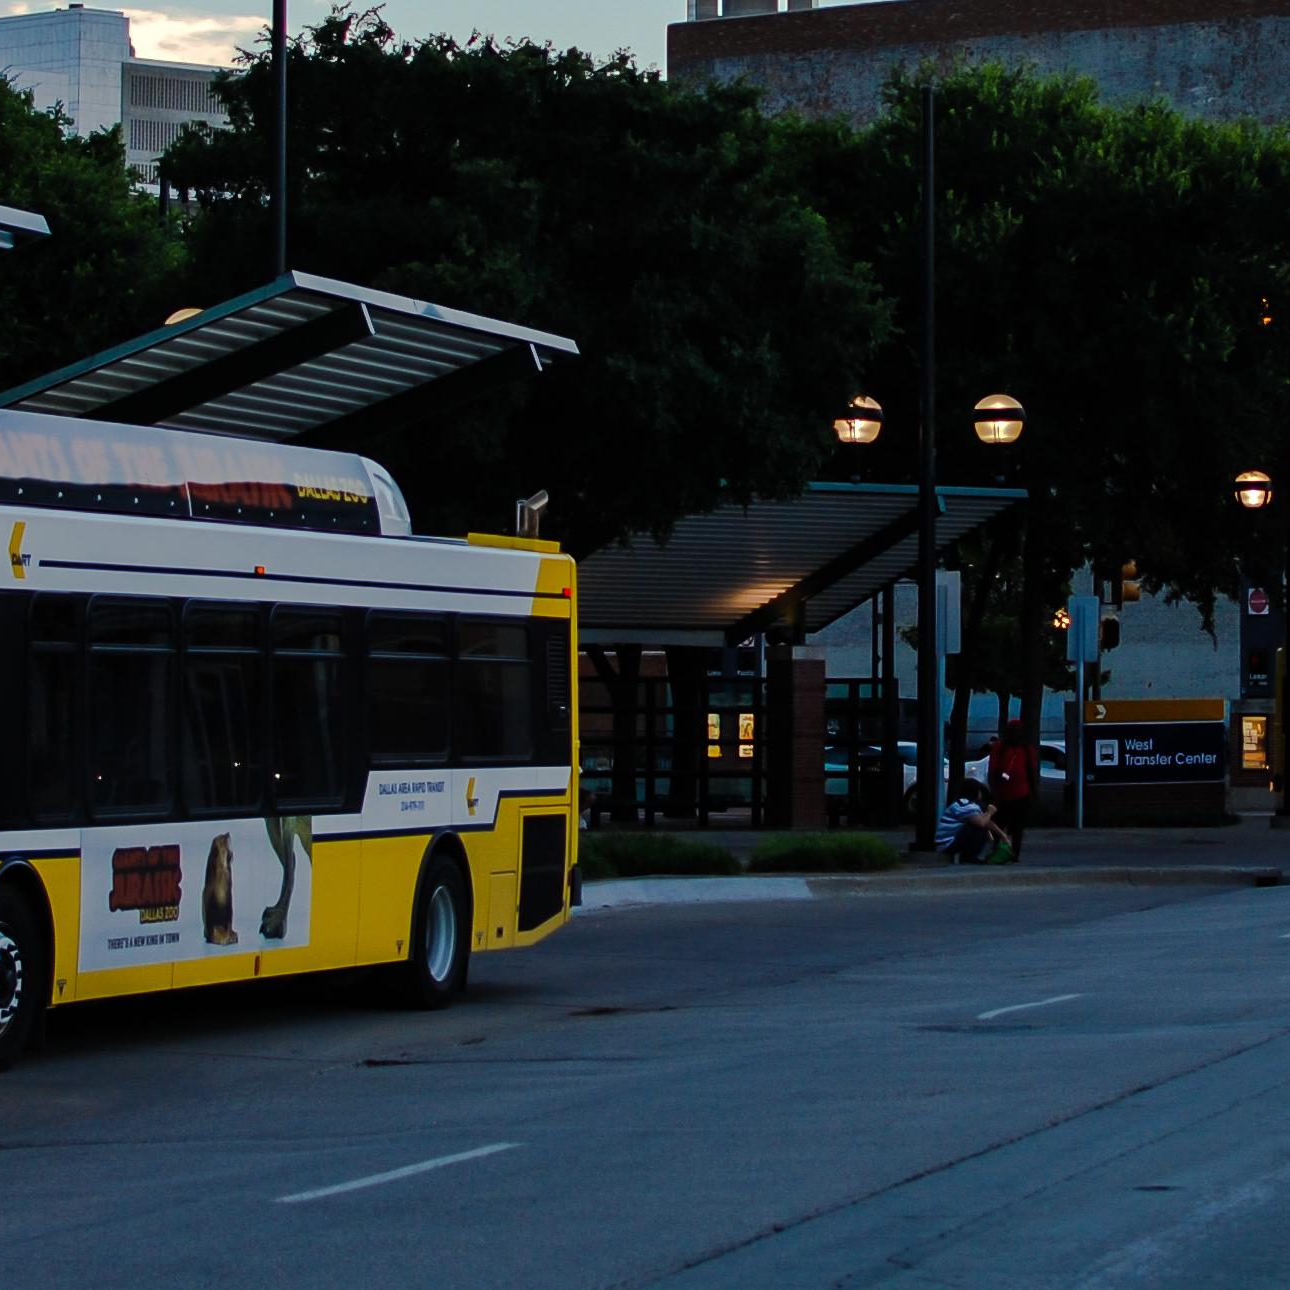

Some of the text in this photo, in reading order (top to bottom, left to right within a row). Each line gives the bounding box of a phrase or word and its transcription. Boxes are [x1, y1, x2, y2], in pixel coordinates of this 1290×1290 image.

[1124, 738, 1153, 751] West
[1125, 752, 1217, 767] Transfer Center
[379, 783, 398, 796] DALLAS
[399, 782, 411, 794] AREA
[141, 905, 178, 922] DALLAS ZOO
[134, 936, 145, 947] NEW
[165, 932, 180, 944] TOWN
